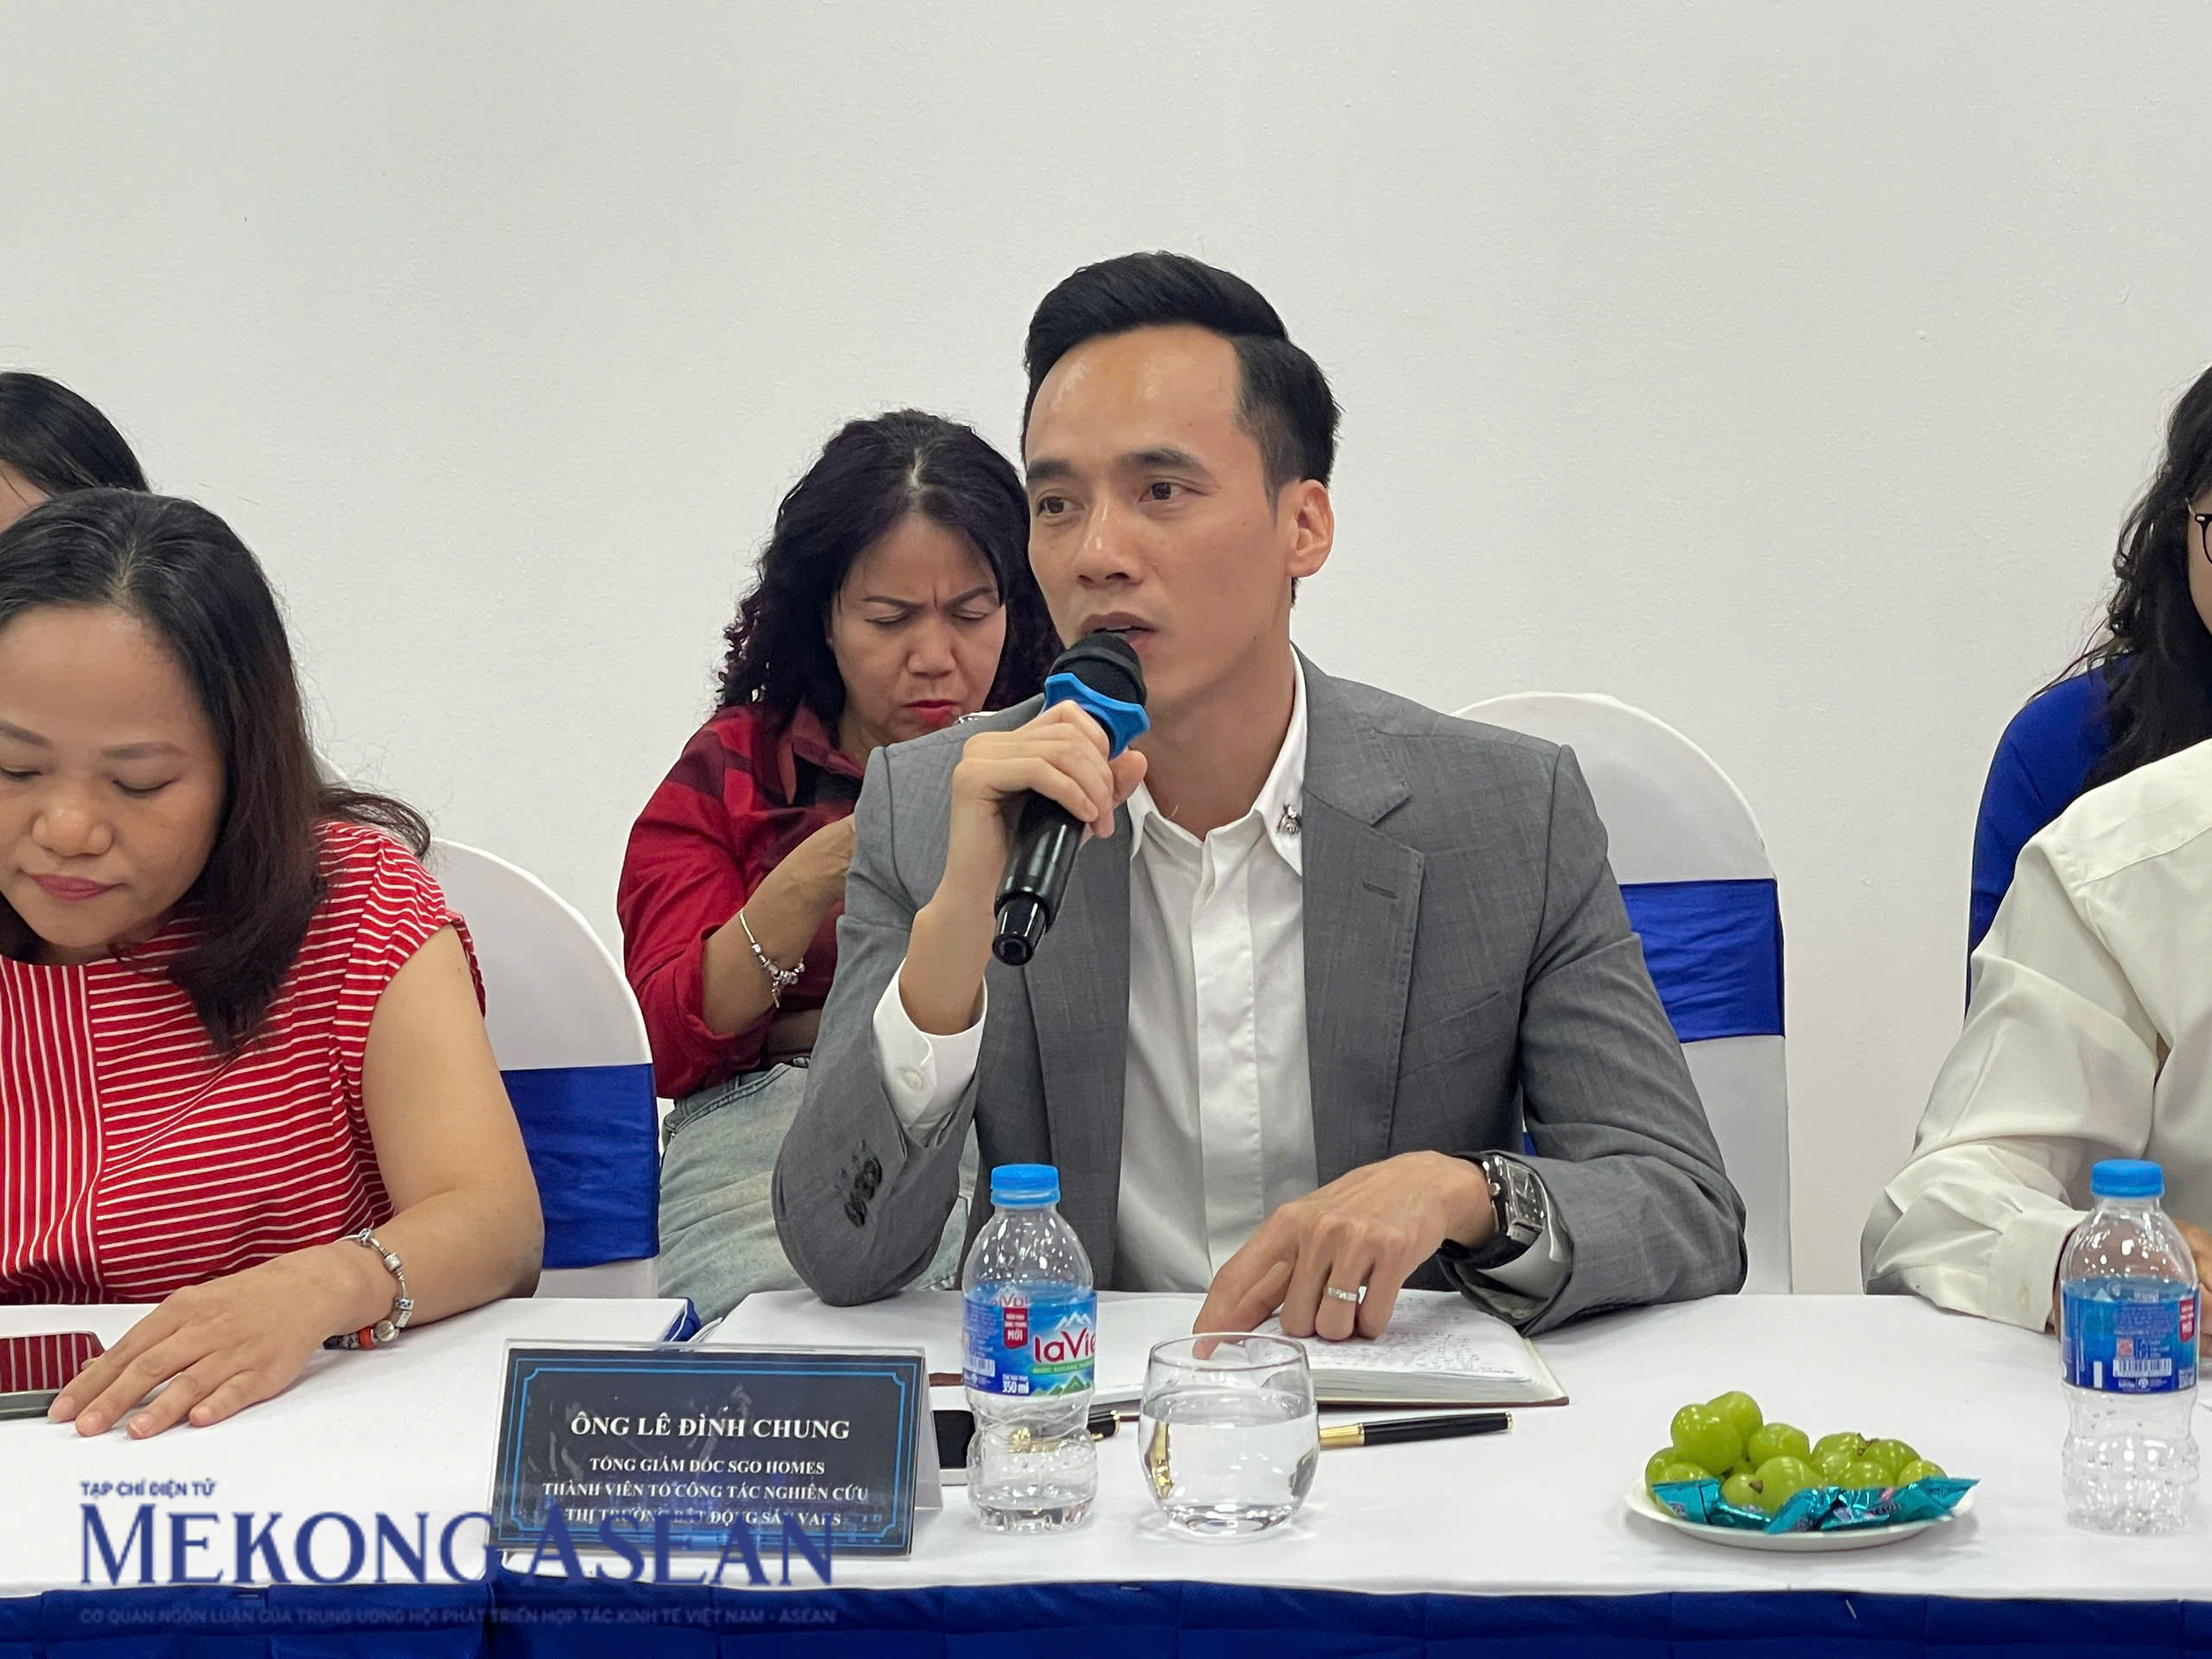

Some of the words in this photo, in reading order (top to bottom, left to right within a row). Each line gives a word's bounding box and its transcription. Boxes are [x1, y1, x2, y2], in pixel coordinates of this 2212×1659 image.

[1002, 1381, 1017, 1394] 350
[570, 1410, 630, 1436] ÔNG
[637, 1412, 671, 1436] LÊ
[678, 1413, 745, 1438] ĐÌNH
[753, 1419, 850, 1440] CHUNG
[728, 1459, 762, 1474] SGO
[766, 1460, 825, 1475] HOMES
[605, 1480, 645, 1497] VIÊN
[674, 1481, 723, 1498] CÔNG
[763, 1483, 829, 1501] NGHIÊN
[709, 1507, 759, 1526] ĐỘG
